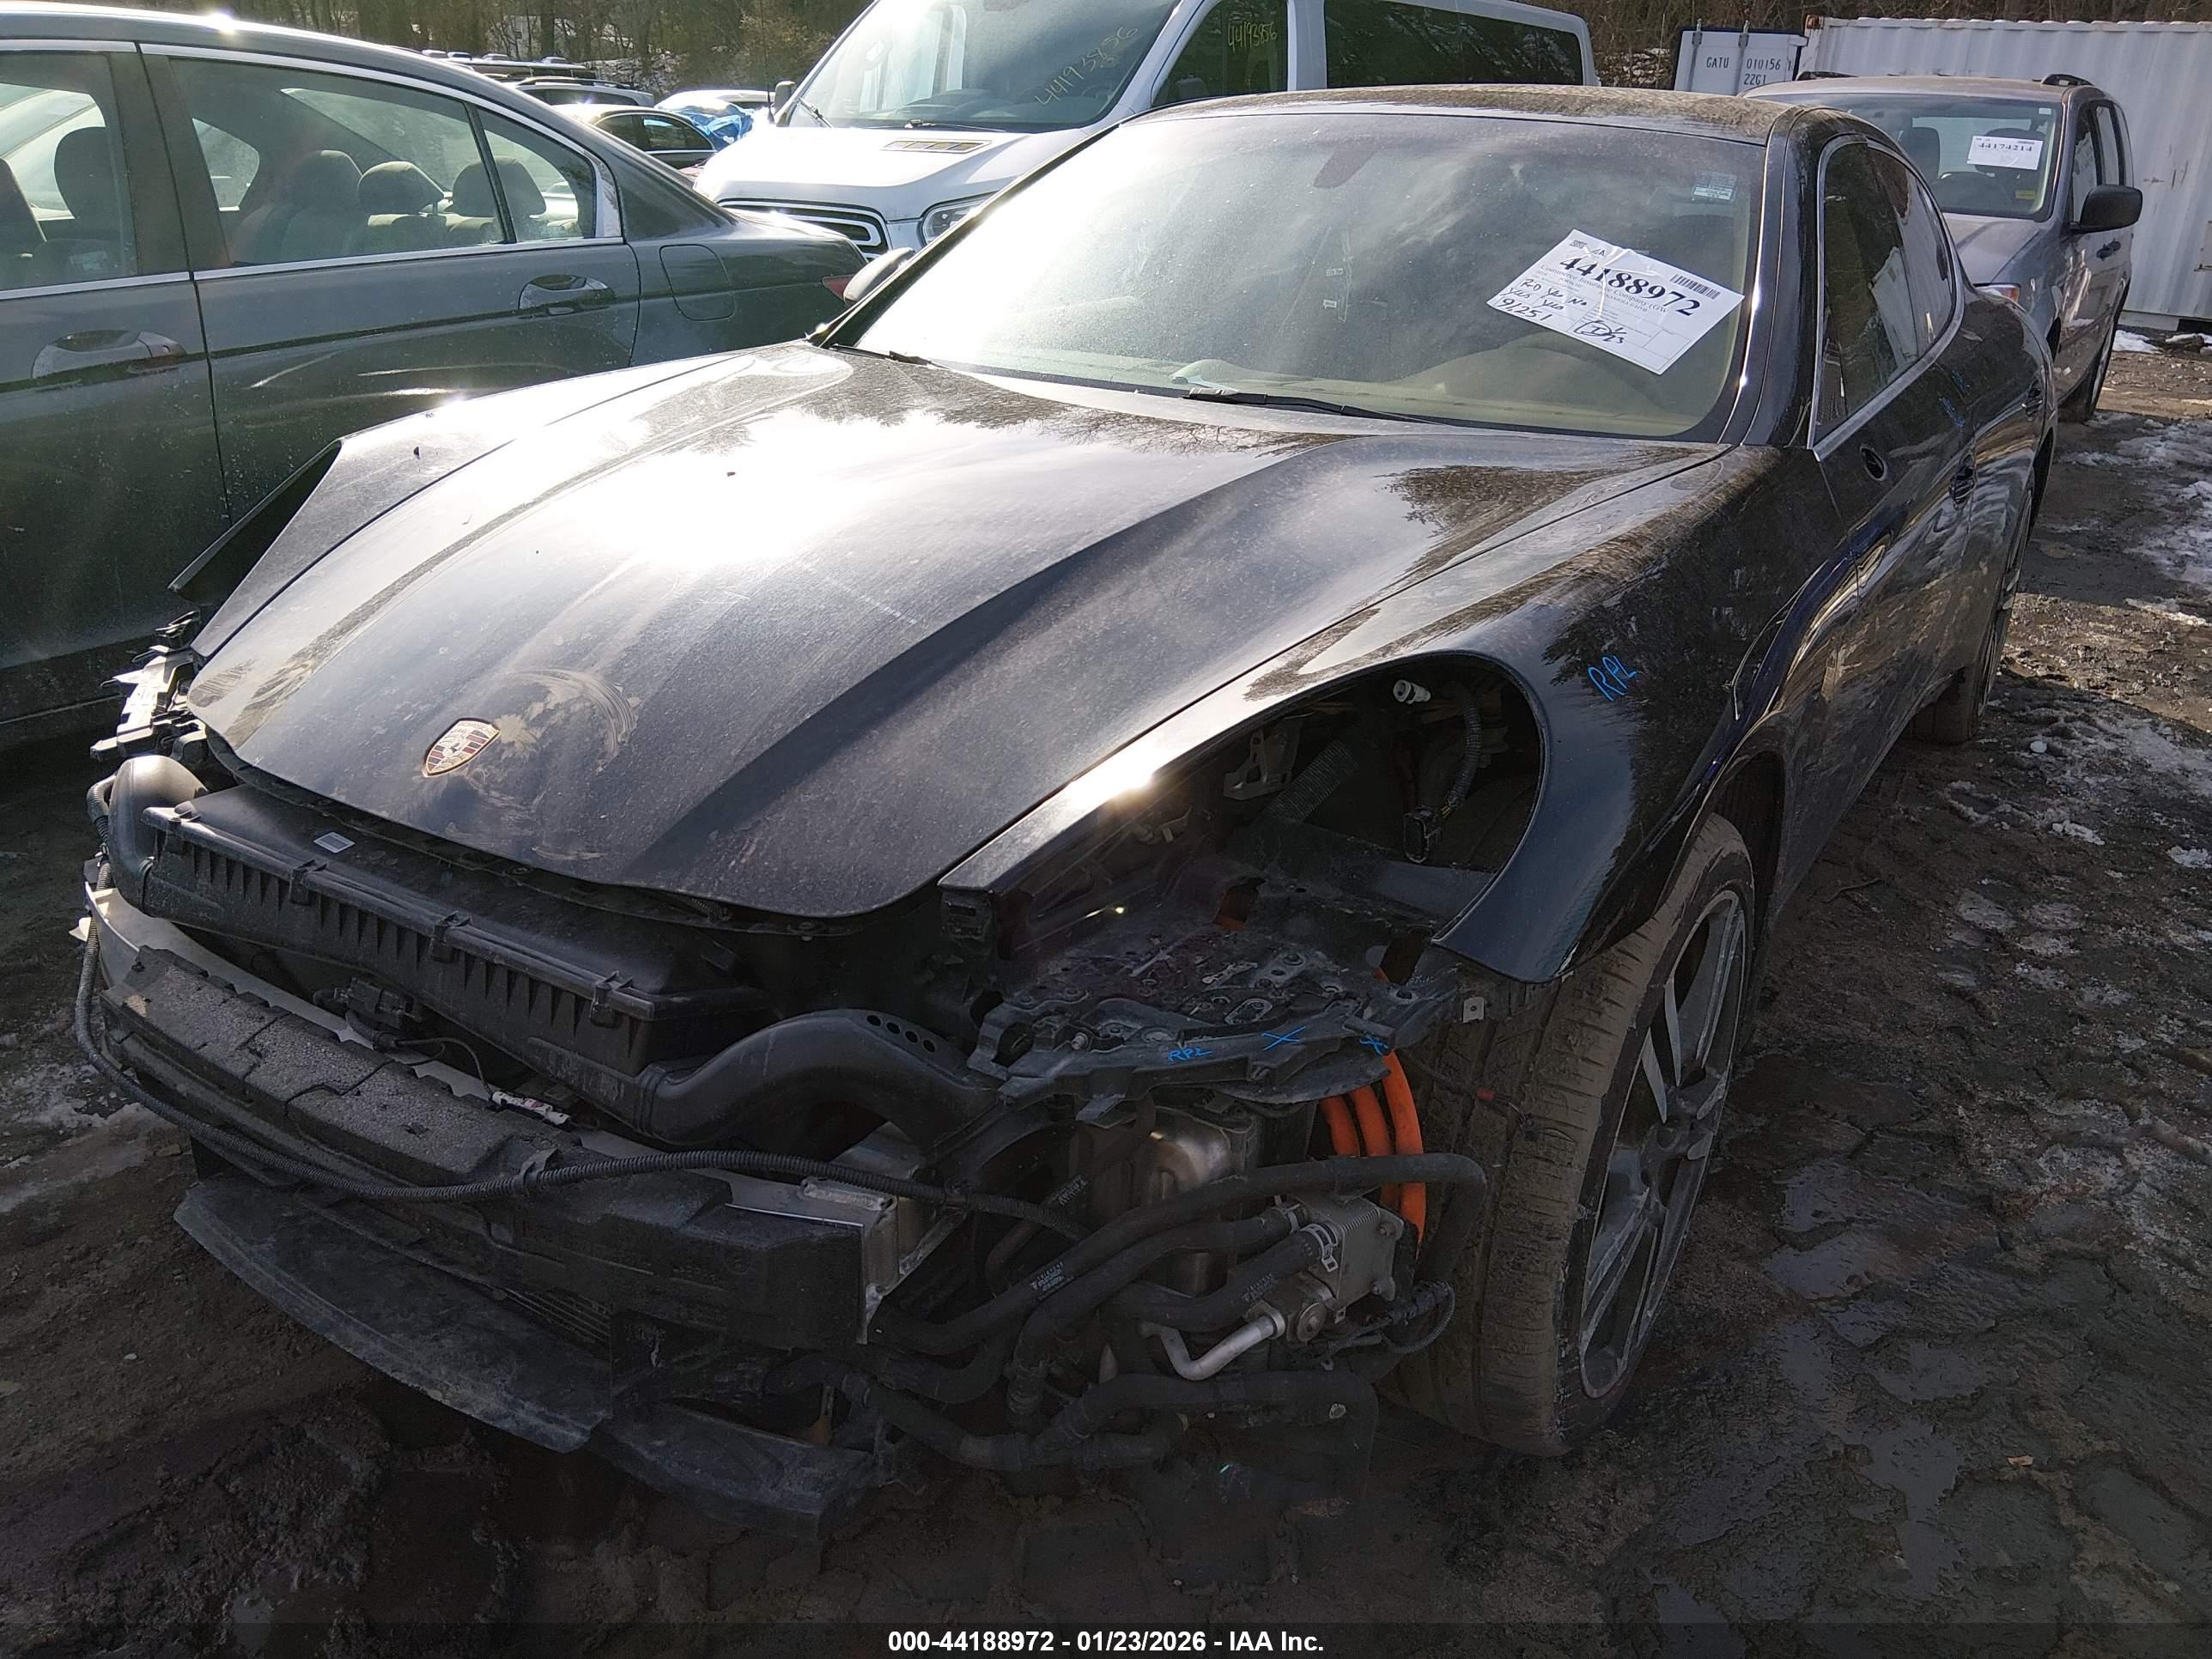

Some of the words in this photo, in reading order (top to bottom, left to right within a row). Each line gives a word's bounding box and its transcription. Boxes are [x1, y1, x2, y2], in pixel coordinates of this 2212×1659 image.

[1228, 21, 1278, 53] 44193856
[1706, 57, 1730, 69] GATU
[1746, 58, 1782, 70] 010156
[1743, 73, 1767, 85] 22G1
[1978, 143, 2033, 152] 44174214
[1559, 258, 1701, 317] 44188972
[1613, 289, 1648, 307] Company
[1587, 655, 1638, 702] RPL
[1167, 1044, 1214, 1062] RPL
